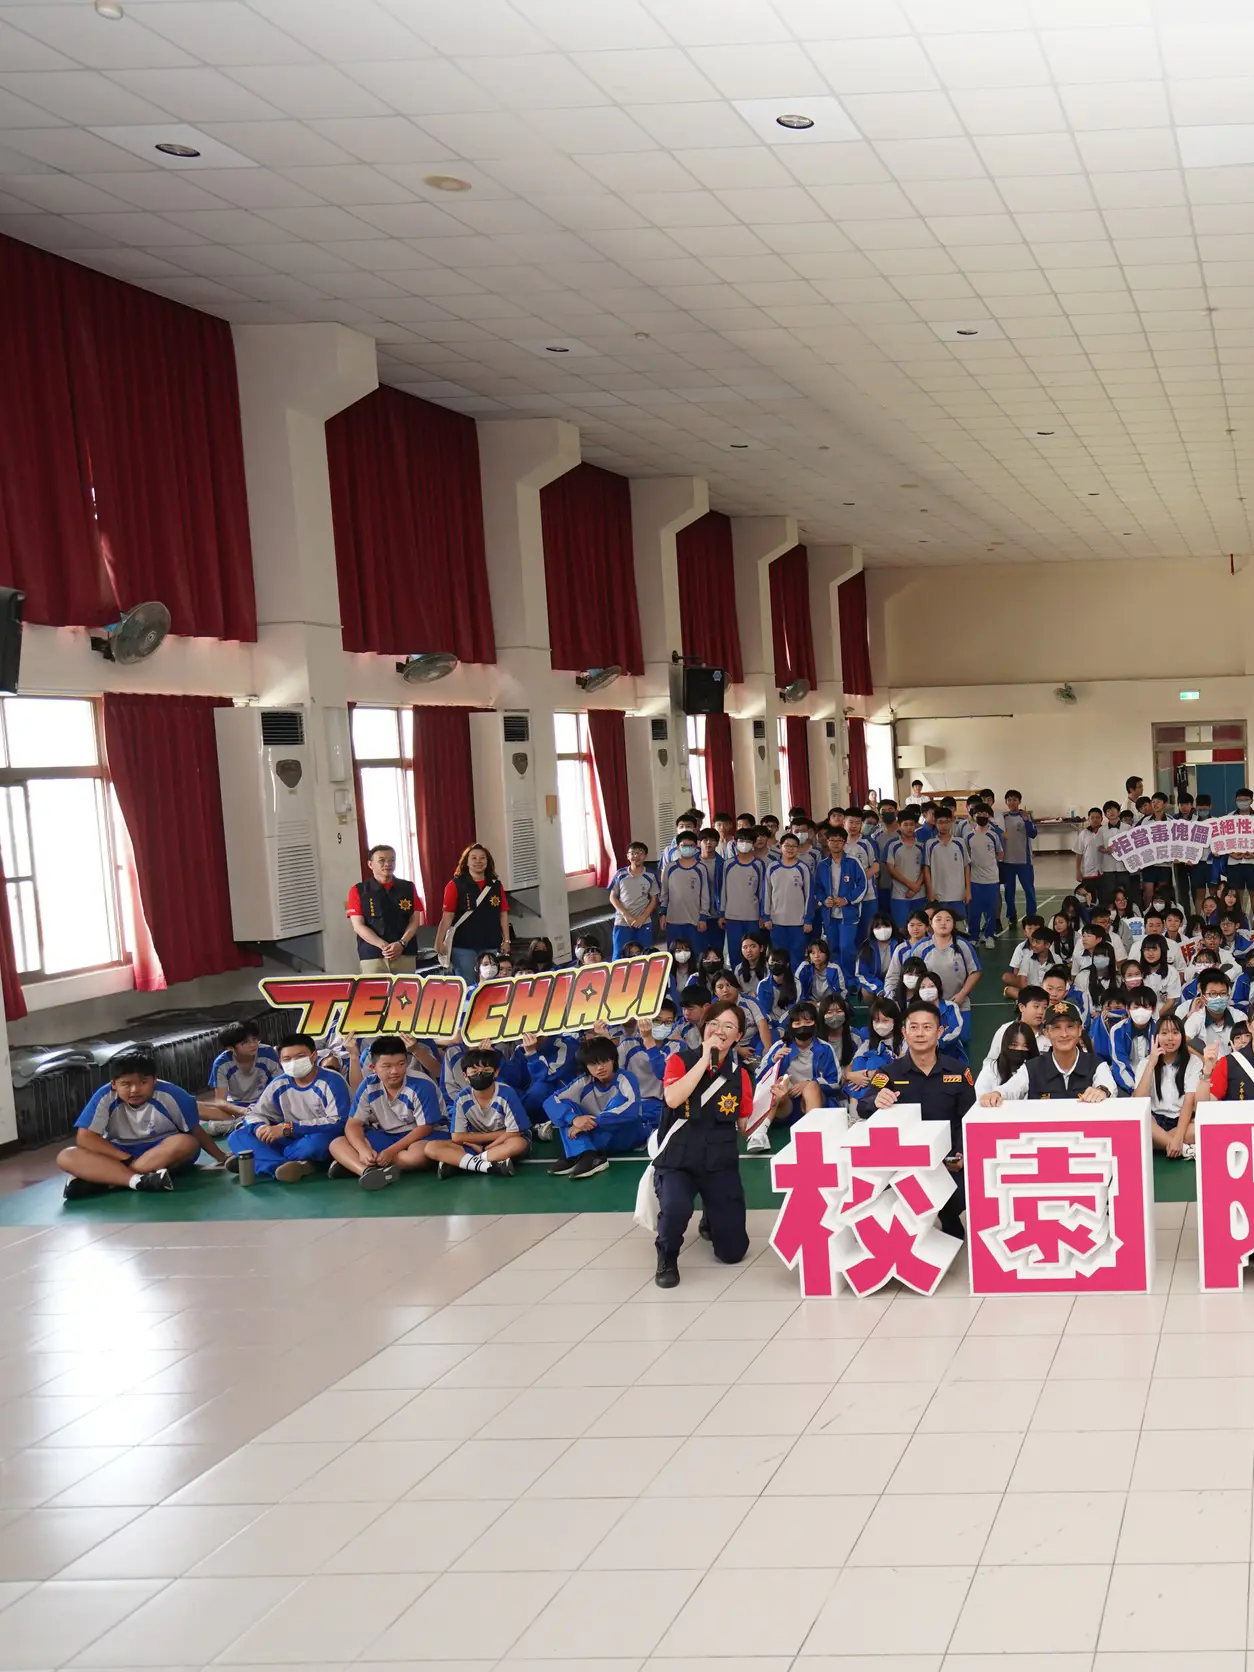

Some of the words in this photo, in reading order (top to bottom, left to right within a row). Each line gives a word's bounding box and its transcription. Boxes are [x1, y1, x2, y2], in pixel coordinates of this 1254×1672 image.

[1111, 822, 1210, 857] 拒當毒傀儡
[262, 977, 462, 1036] TEAM
